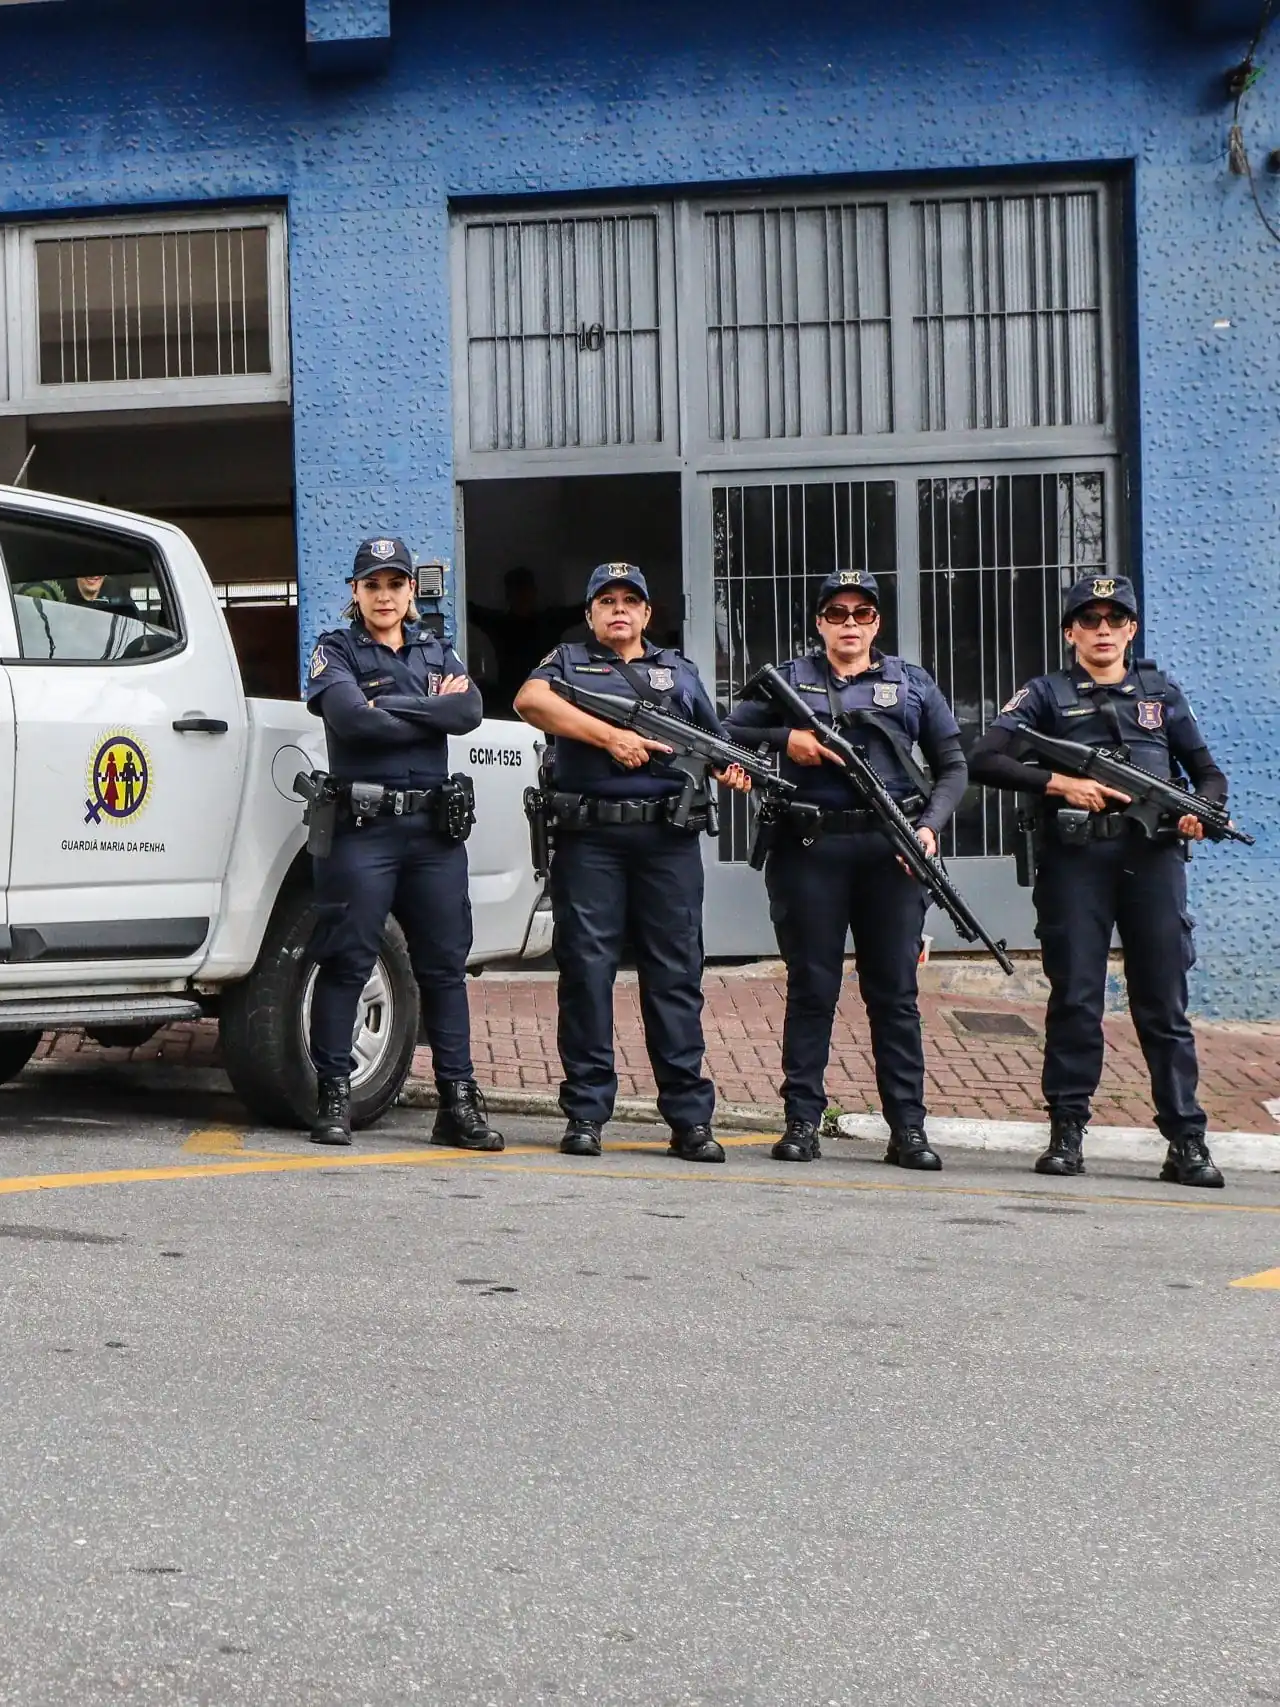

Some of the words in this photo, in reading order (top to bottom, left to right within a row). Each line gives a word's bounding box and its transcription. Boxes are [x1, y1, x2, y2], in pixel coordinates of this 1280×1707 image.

[469, 747, 522, 766] GCM-1525
[100, 840, 125, 852] MARIA
[126, 841, 138, 852] DA
[139, 842, 166, 853] PENHA
